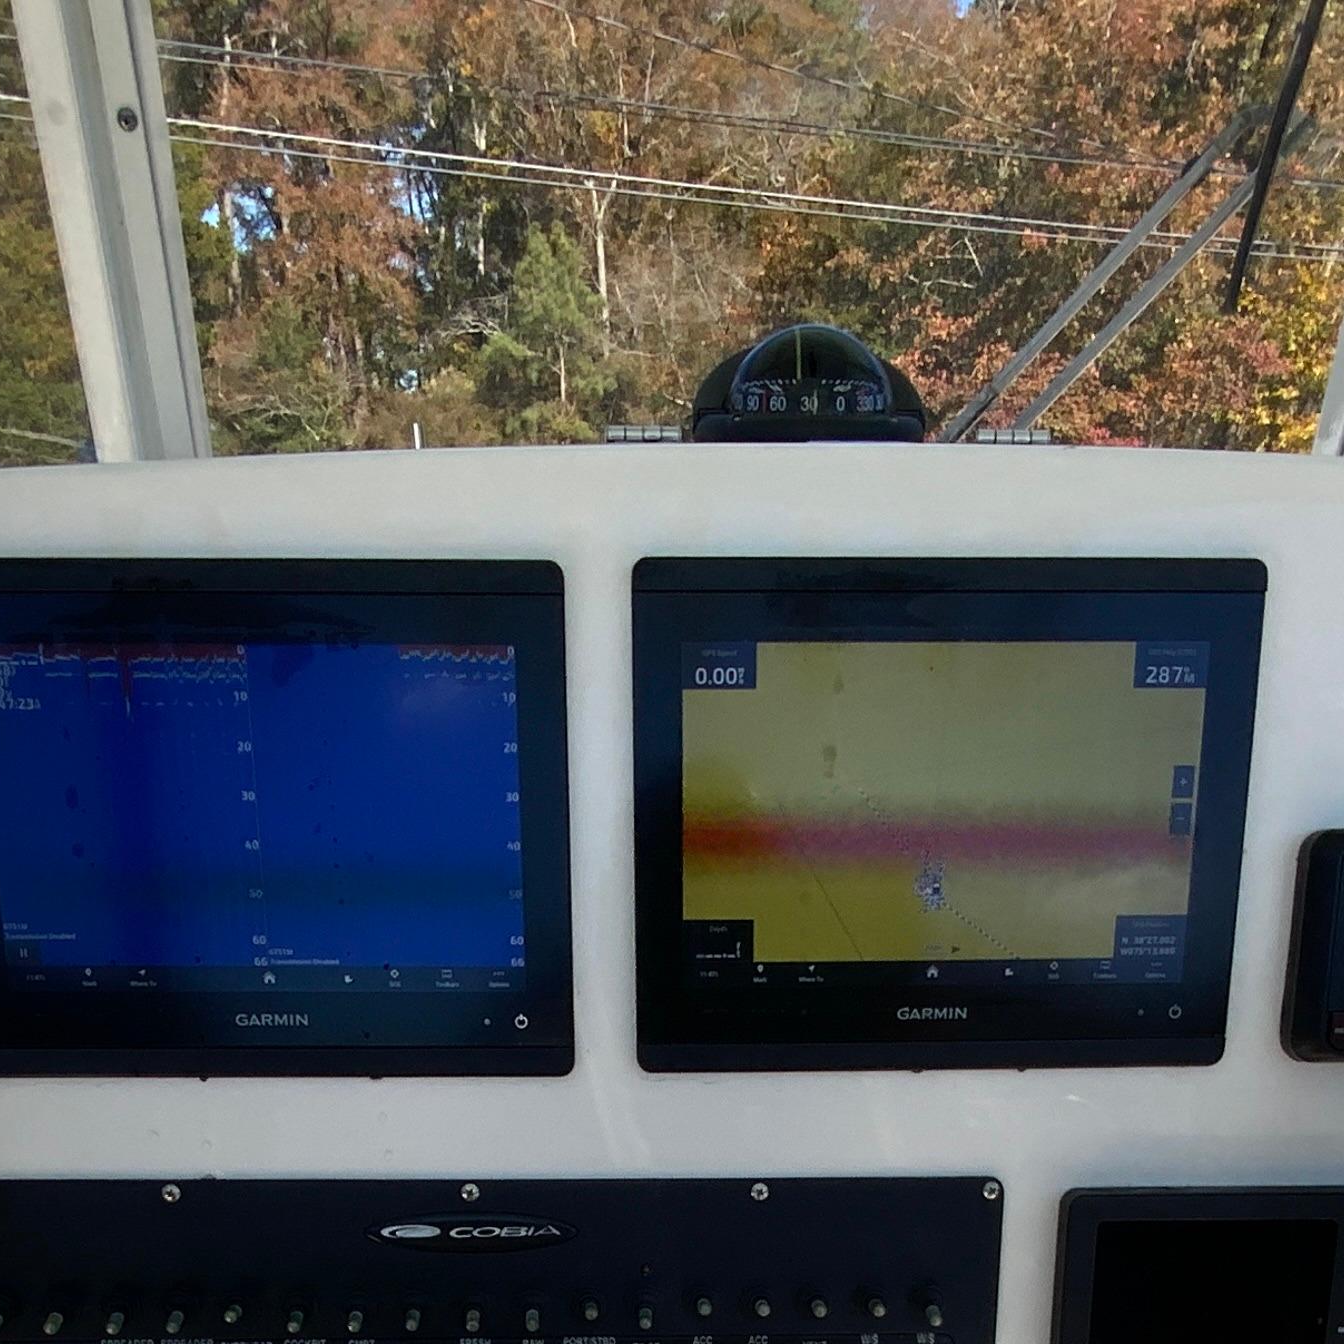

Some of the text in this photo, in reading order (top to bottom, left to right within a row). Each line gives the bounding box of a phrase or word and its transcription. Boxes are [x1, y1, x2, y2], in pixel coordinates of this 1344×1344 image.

[769, 396, 787, 412] 60
[836, 396, 846, 412] 0
[504, 742, 518, 752] 20
[241, 790, 255, 800] 30
[506, 792, 519, 801] 30
[252, 934, 267, 945] 60
[510, 935, 524, 945] 60
[897, 1006, 967, 1020] GARMIN
[235, 1013, 309, 1027] GARMIN
[449, 1225, 561, 1238] COBIA
[748, 1335, 768, 1344] ACC
